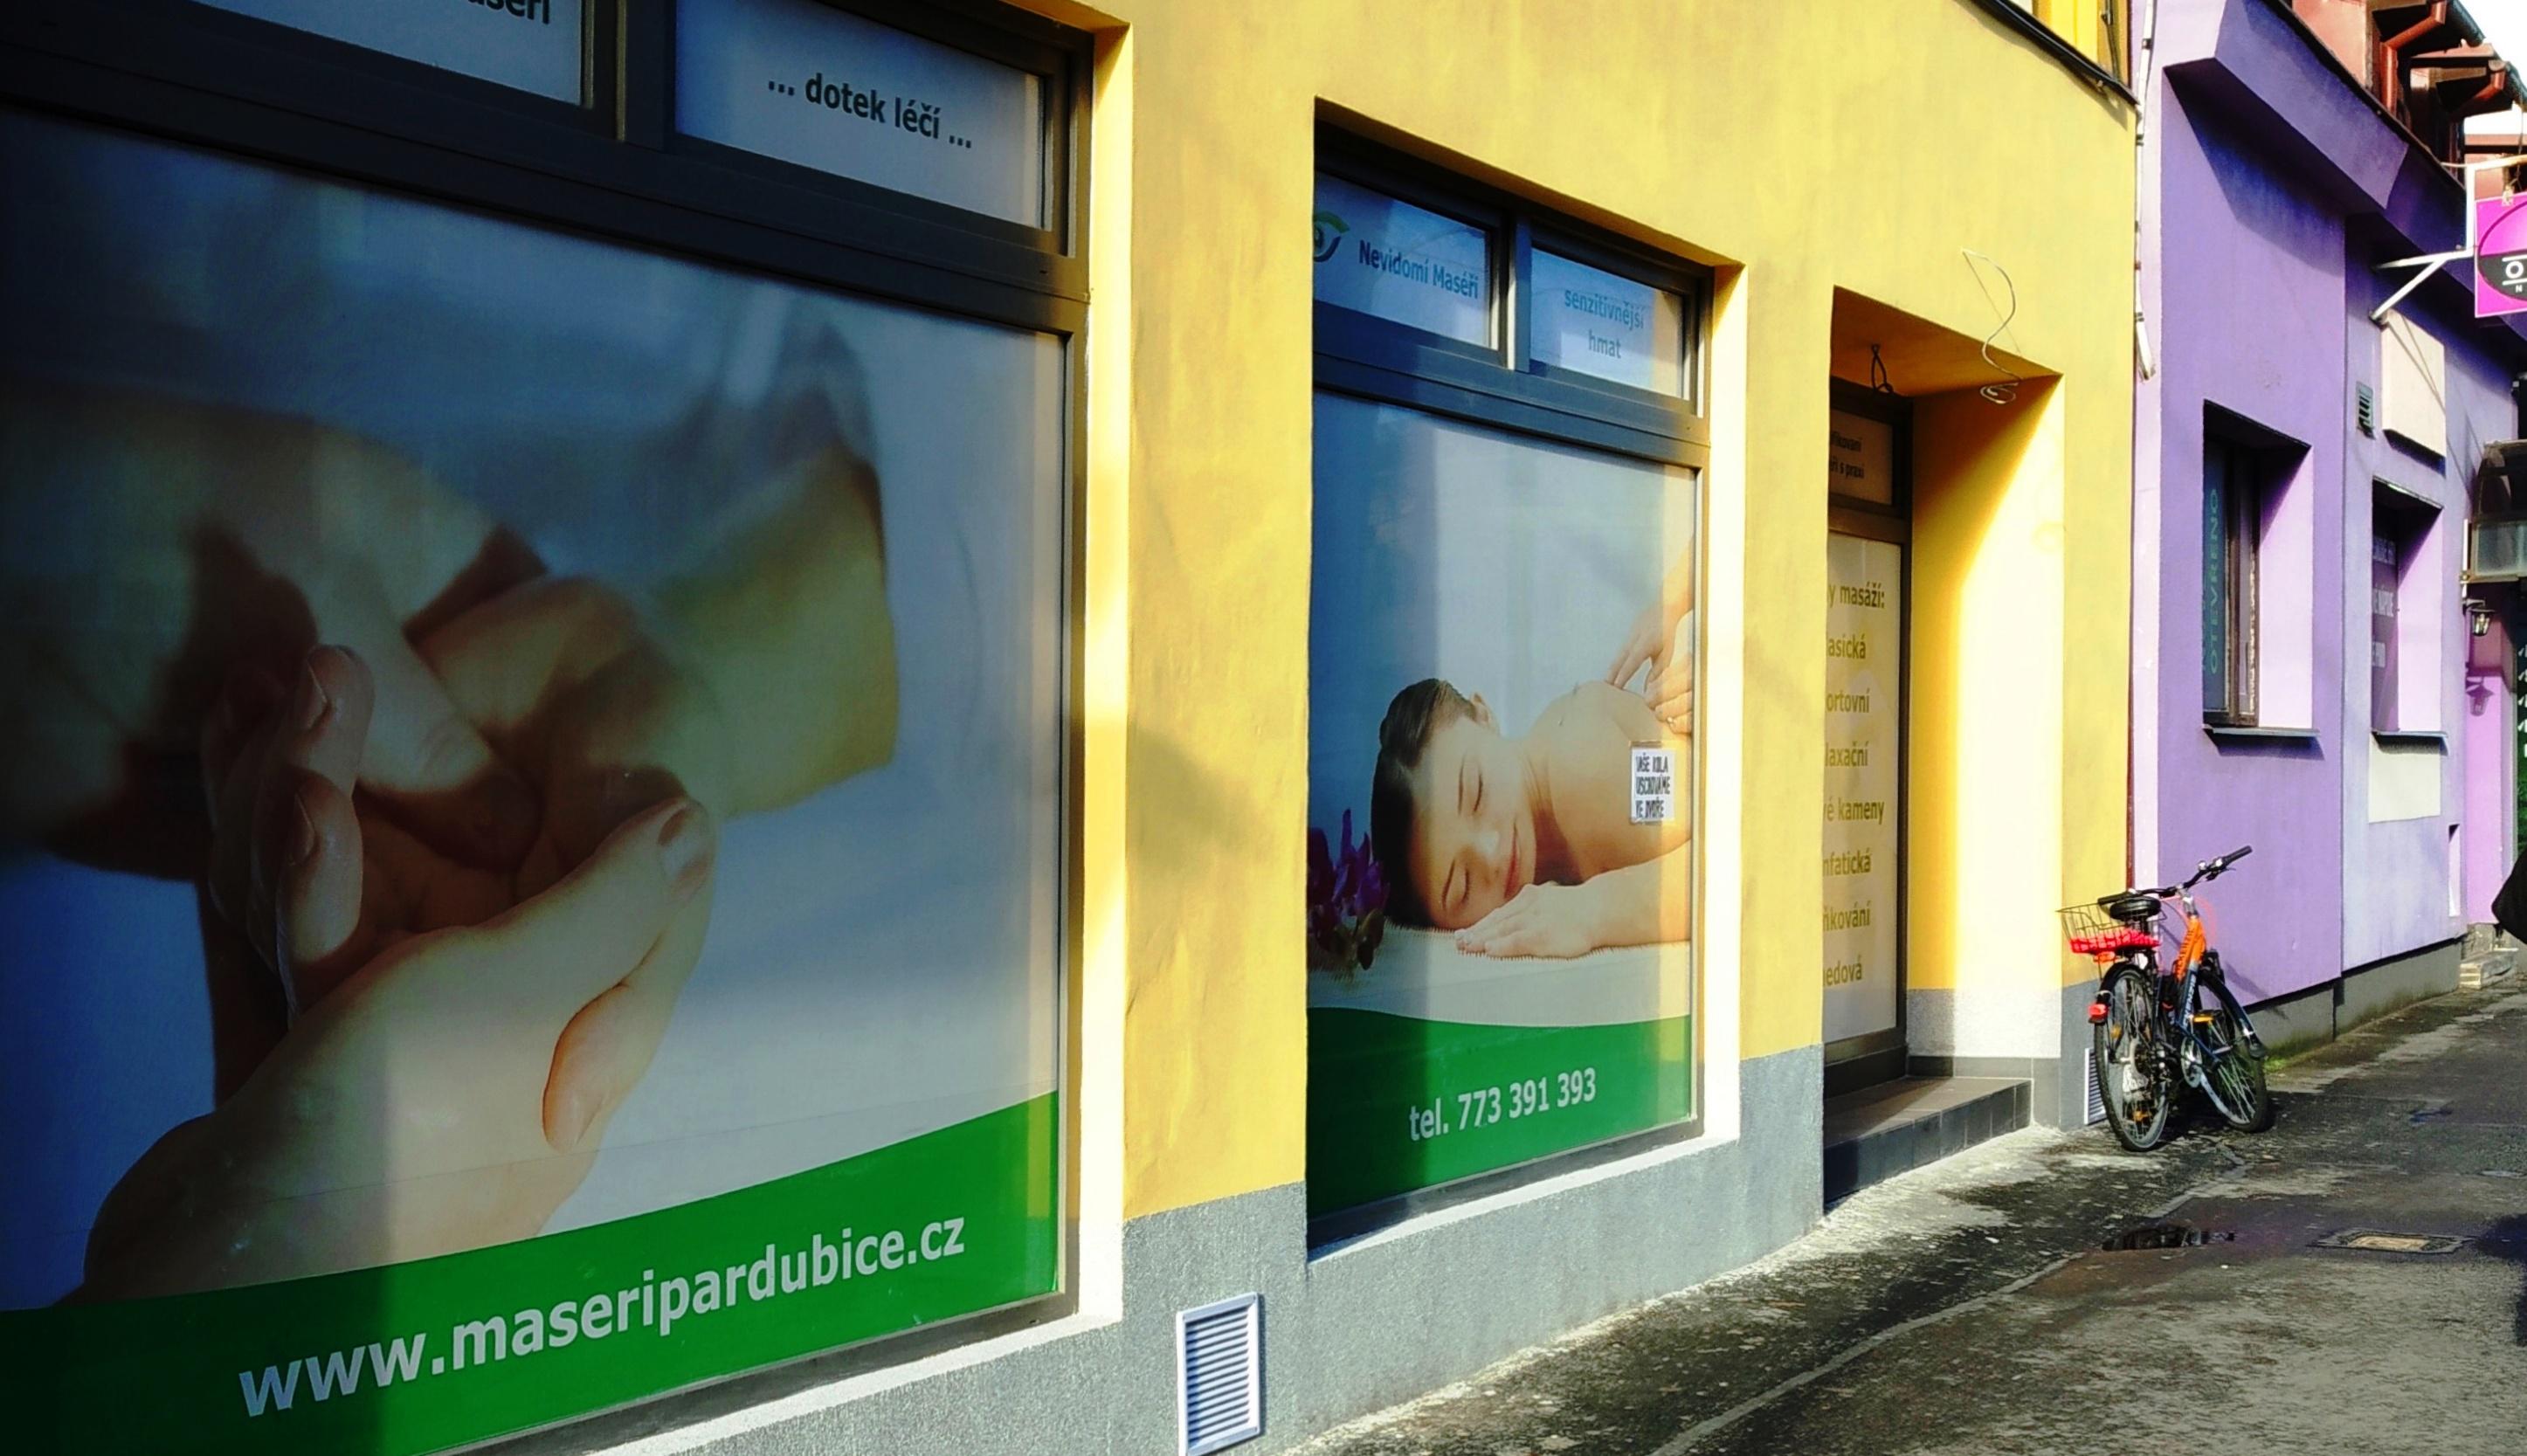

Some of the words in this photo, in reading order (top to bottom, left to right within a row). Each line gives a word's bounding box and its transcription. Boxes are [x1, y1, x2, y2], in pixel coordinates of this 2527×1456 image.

[805, 72, 886, 123] dotek
[895, 97, 941, 139] léčí
[1359, 239, 1429, 284] Nevidomí
[1433, 266, 1478, 299] Maséři
[1564, 289, 1644, 331] senzitivnější
[1589, 329, 1621, 359] hmat
[1840, 581, 1885, 608] masáží:
[1838, 797, 1885, 825] kameny
[1410, 1098, 1449, 1141] tel.
[1458, 1087, 1502, 1130] 773
[1509, 1077, 1550, 1119] 391
[1557, 1067, 1597, 1108] 393
[239, 1217, 965, 1418] www.maseripardubice.cz
